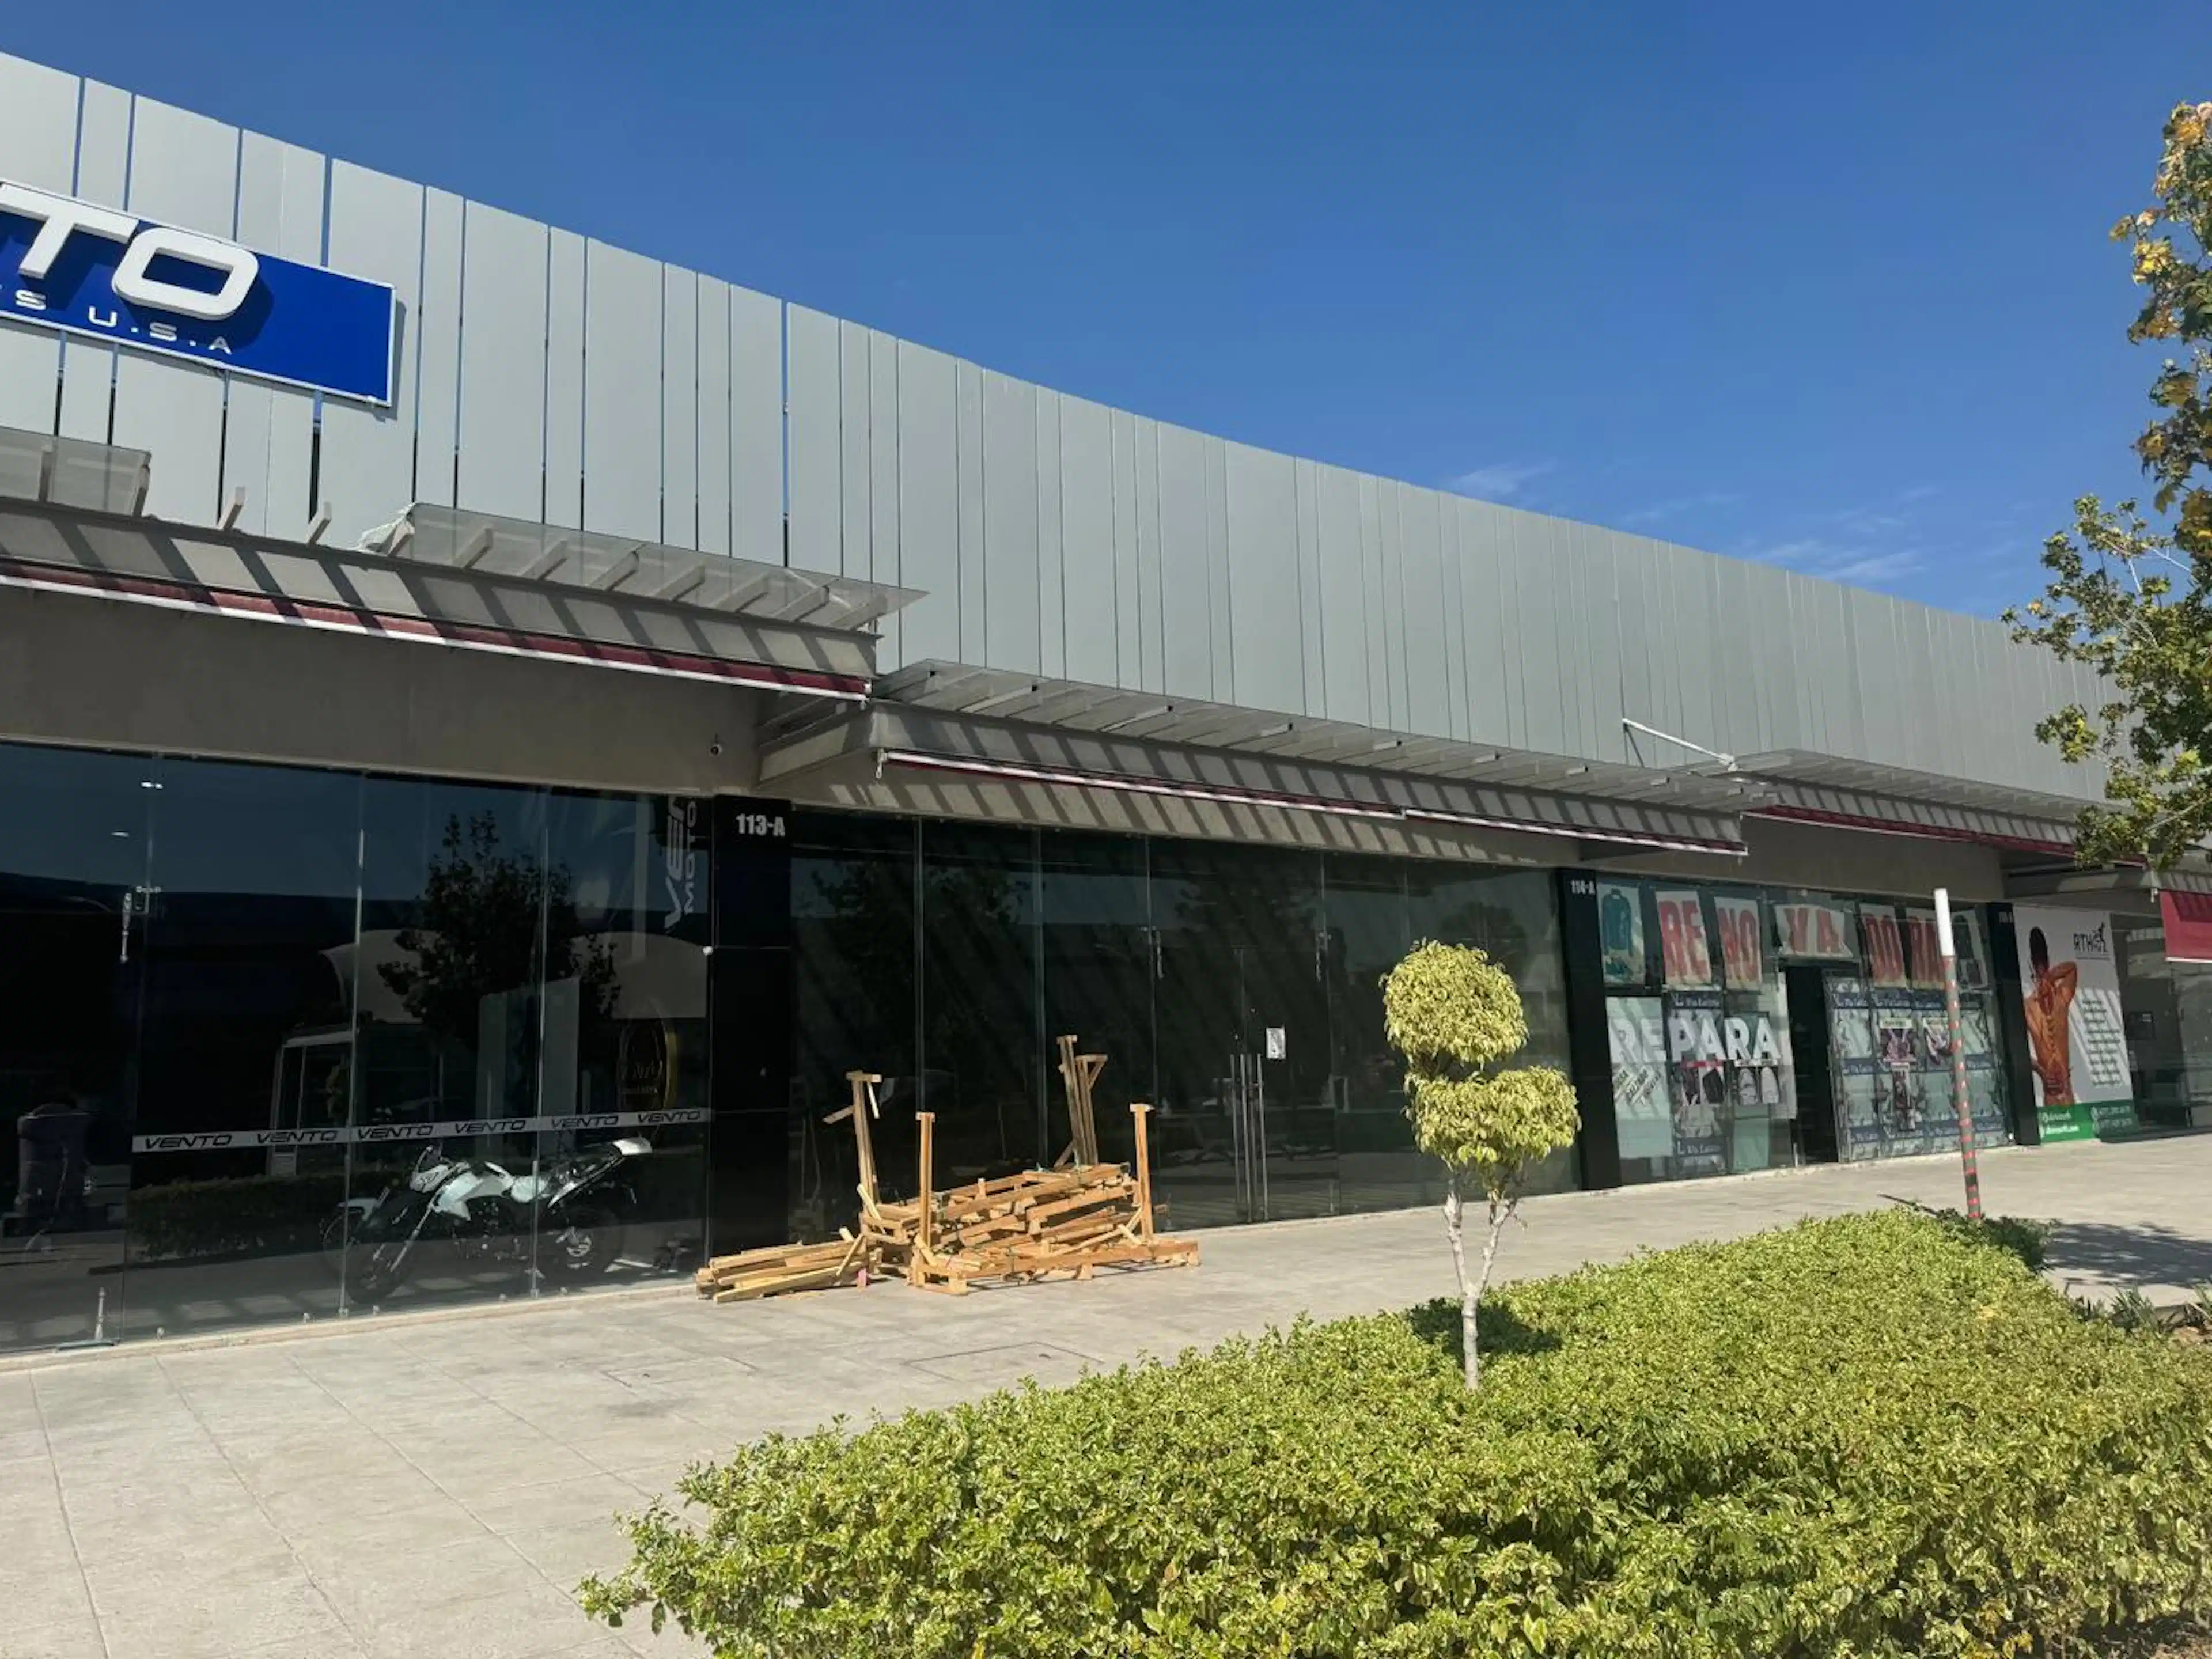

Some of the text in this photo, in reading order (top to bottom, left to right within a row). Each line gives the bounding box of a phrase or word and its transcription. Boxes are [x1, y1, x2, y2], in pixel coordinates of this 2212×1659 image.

[736, 813, 785, 837] 113-A
[145, 1111, 702, 1149] VENTO VENTO VENTO VENTO VENTO VENTO
